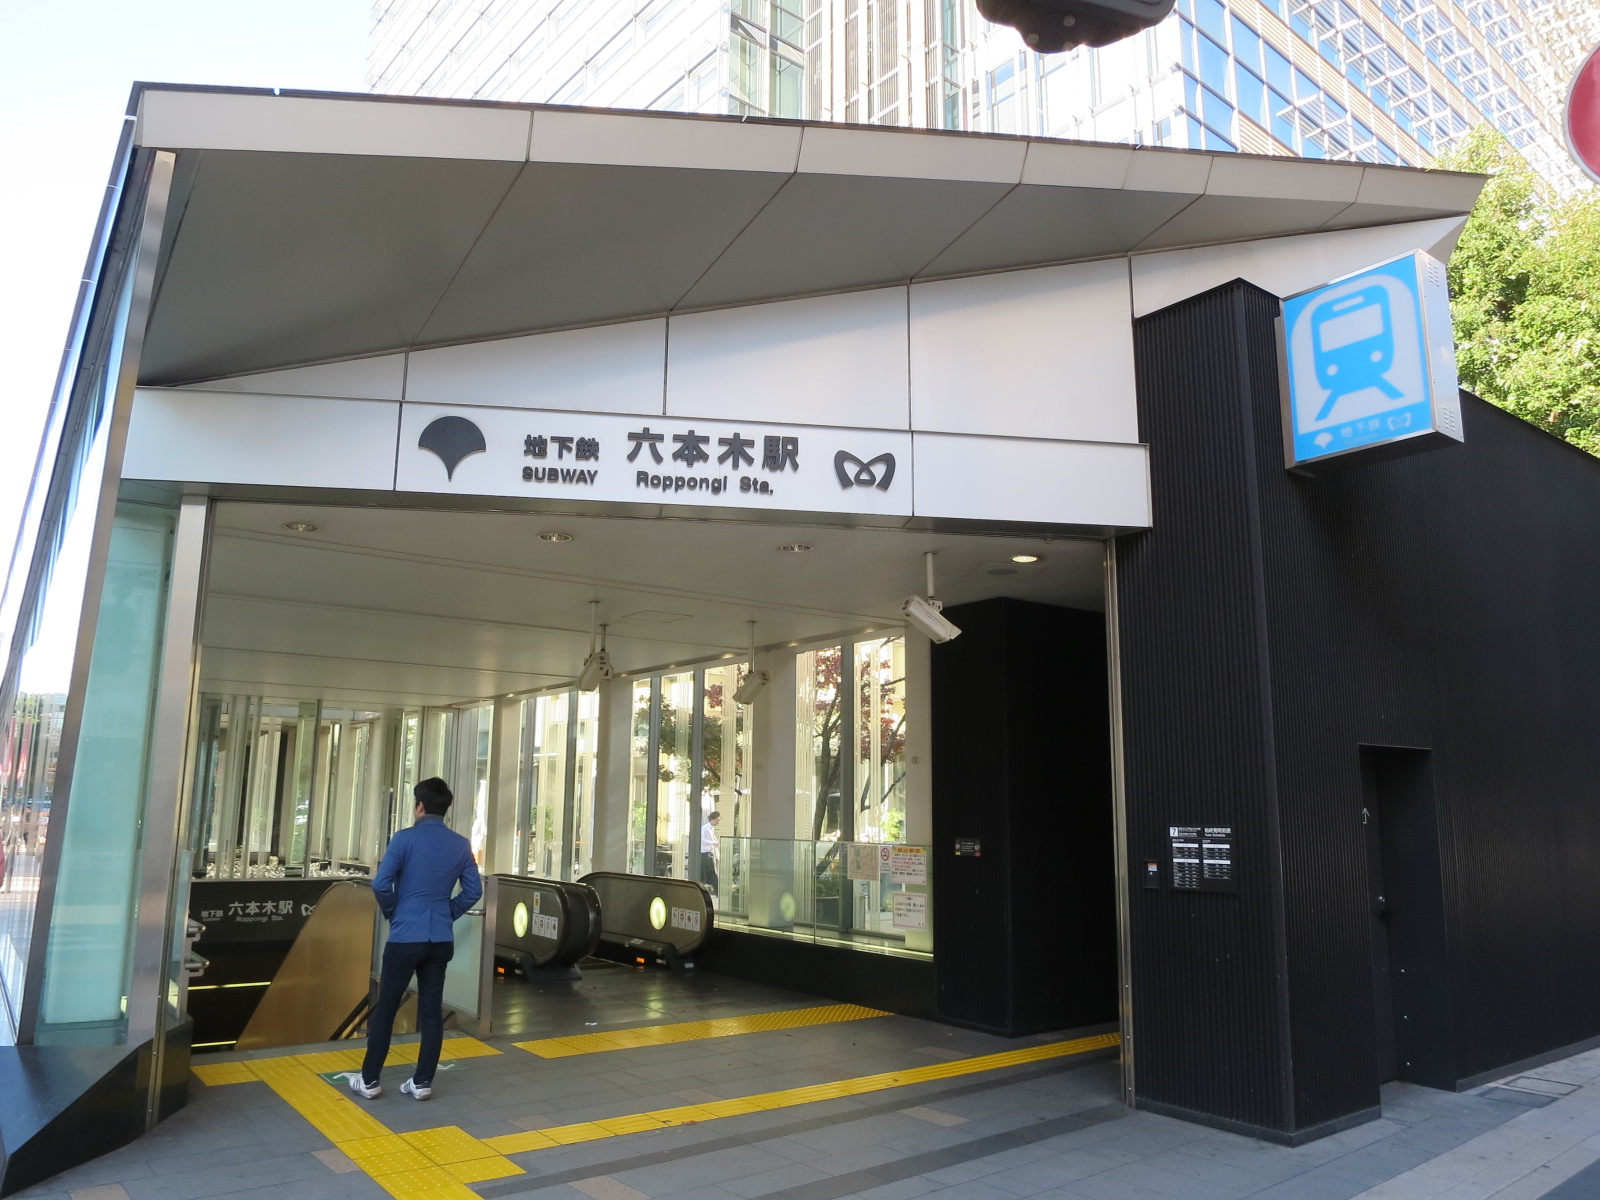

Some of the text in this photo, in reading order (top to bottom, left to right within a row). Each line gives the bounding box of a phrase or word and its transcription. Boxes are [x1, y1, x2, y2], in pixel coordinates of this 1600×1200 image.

[523, 434, 600, 462] 地下鉄
[626, 426, 800, 473] 六本木駅
[522, 465, 599, 486] SUBWAY
[636, 470, 774, 496] Roppongi Sta.
[201, 909, 224, 918] 地下鉄
[228, 900, 294, 916] 六本木駅
